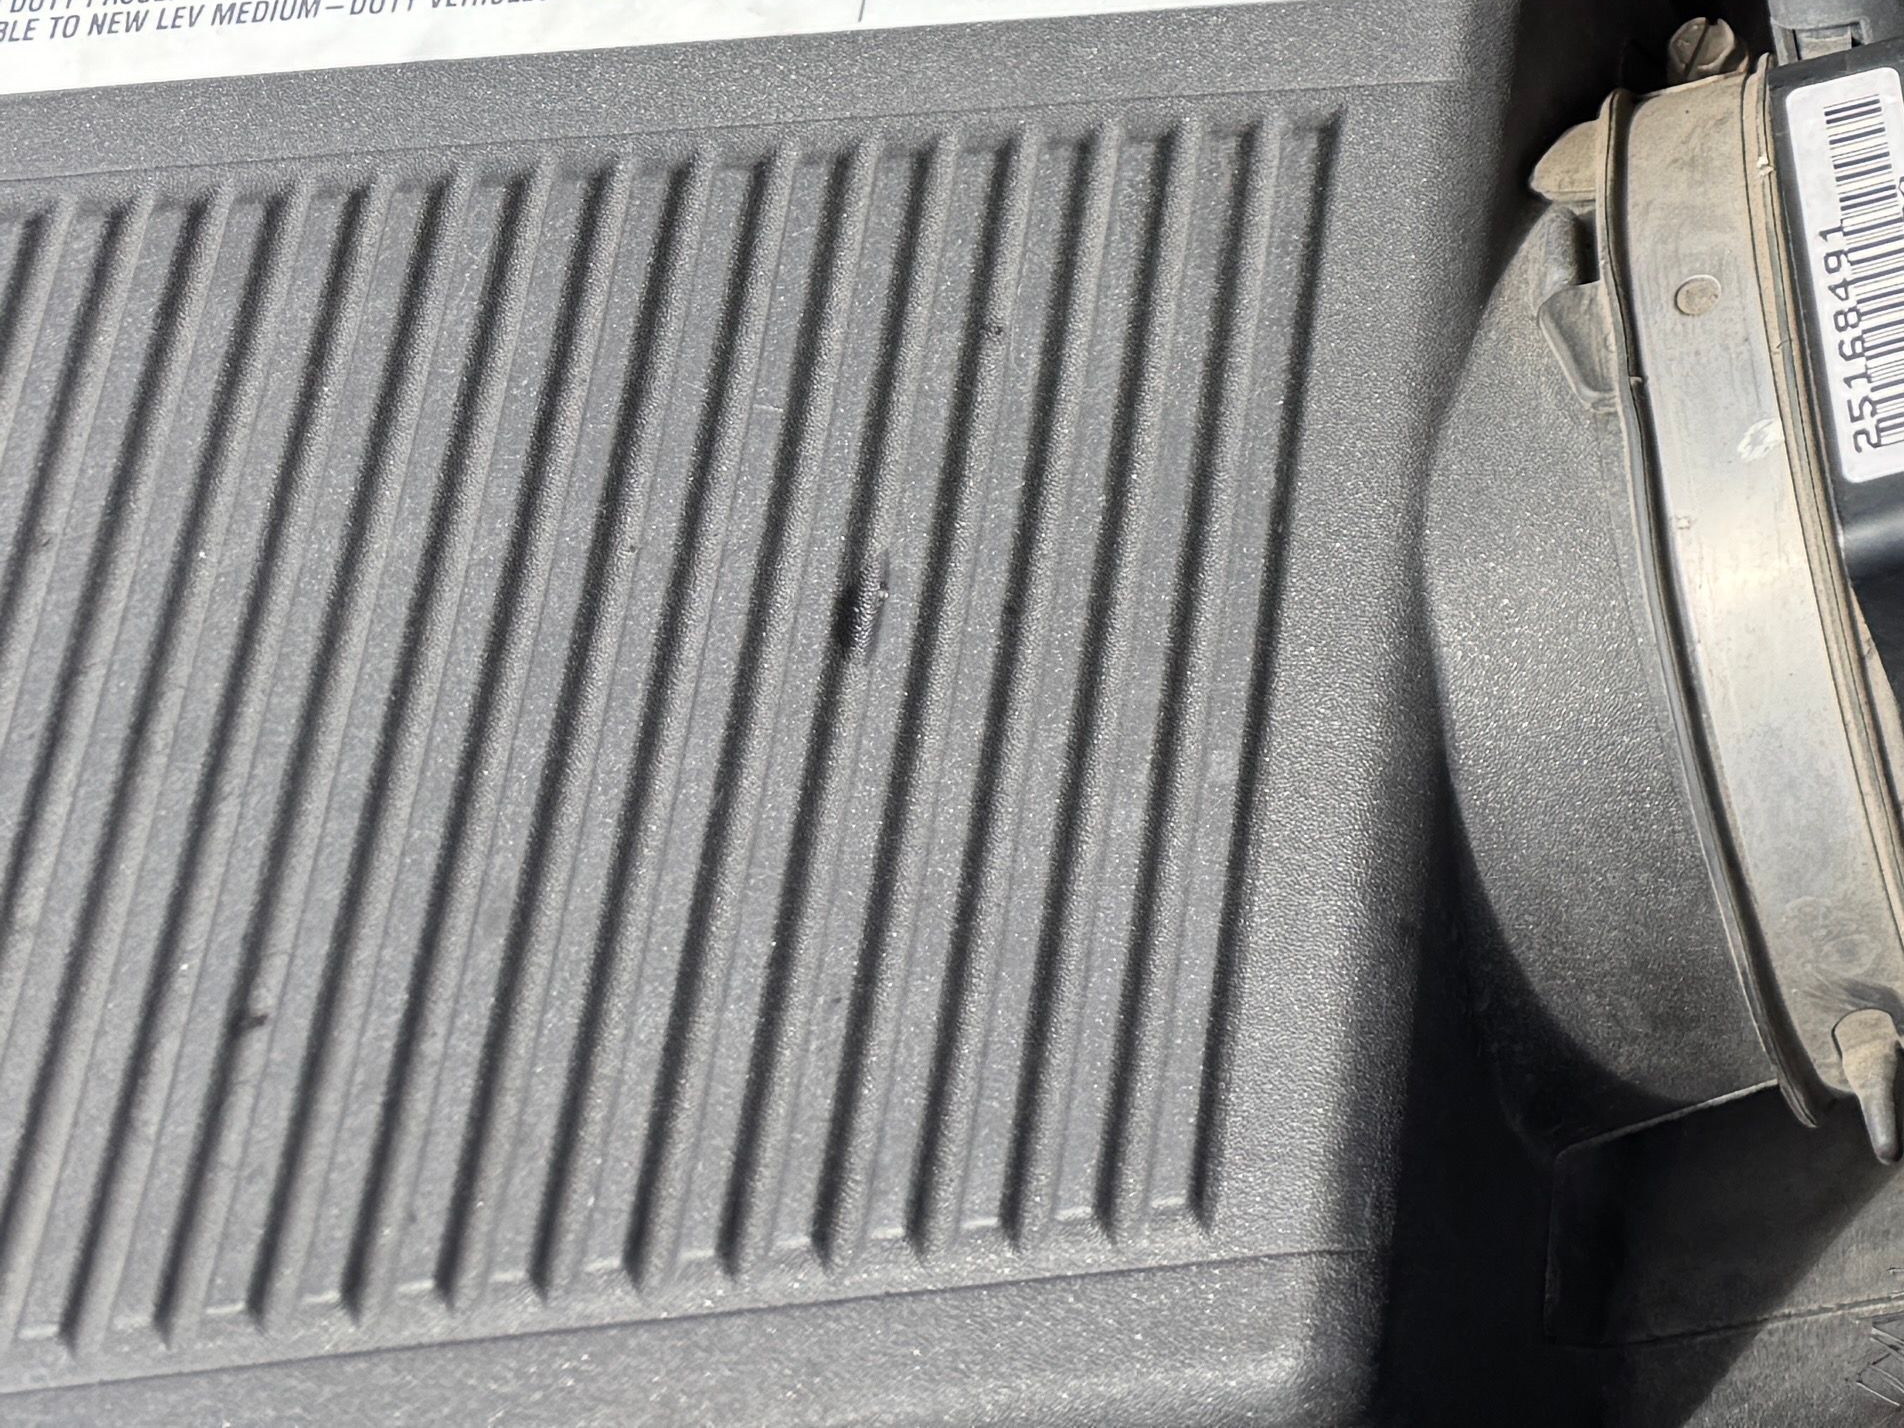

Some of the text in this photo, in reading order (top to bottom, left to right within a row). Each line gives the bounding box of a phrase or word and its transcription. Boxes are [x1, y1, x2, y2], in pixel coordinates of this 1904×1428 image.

[50, 14, 80, 40] TO
[88, 9, 150, 36] NEW
[156, 4, 205, 31] LEV
[1819, 219, 1882, 453] 25168491
